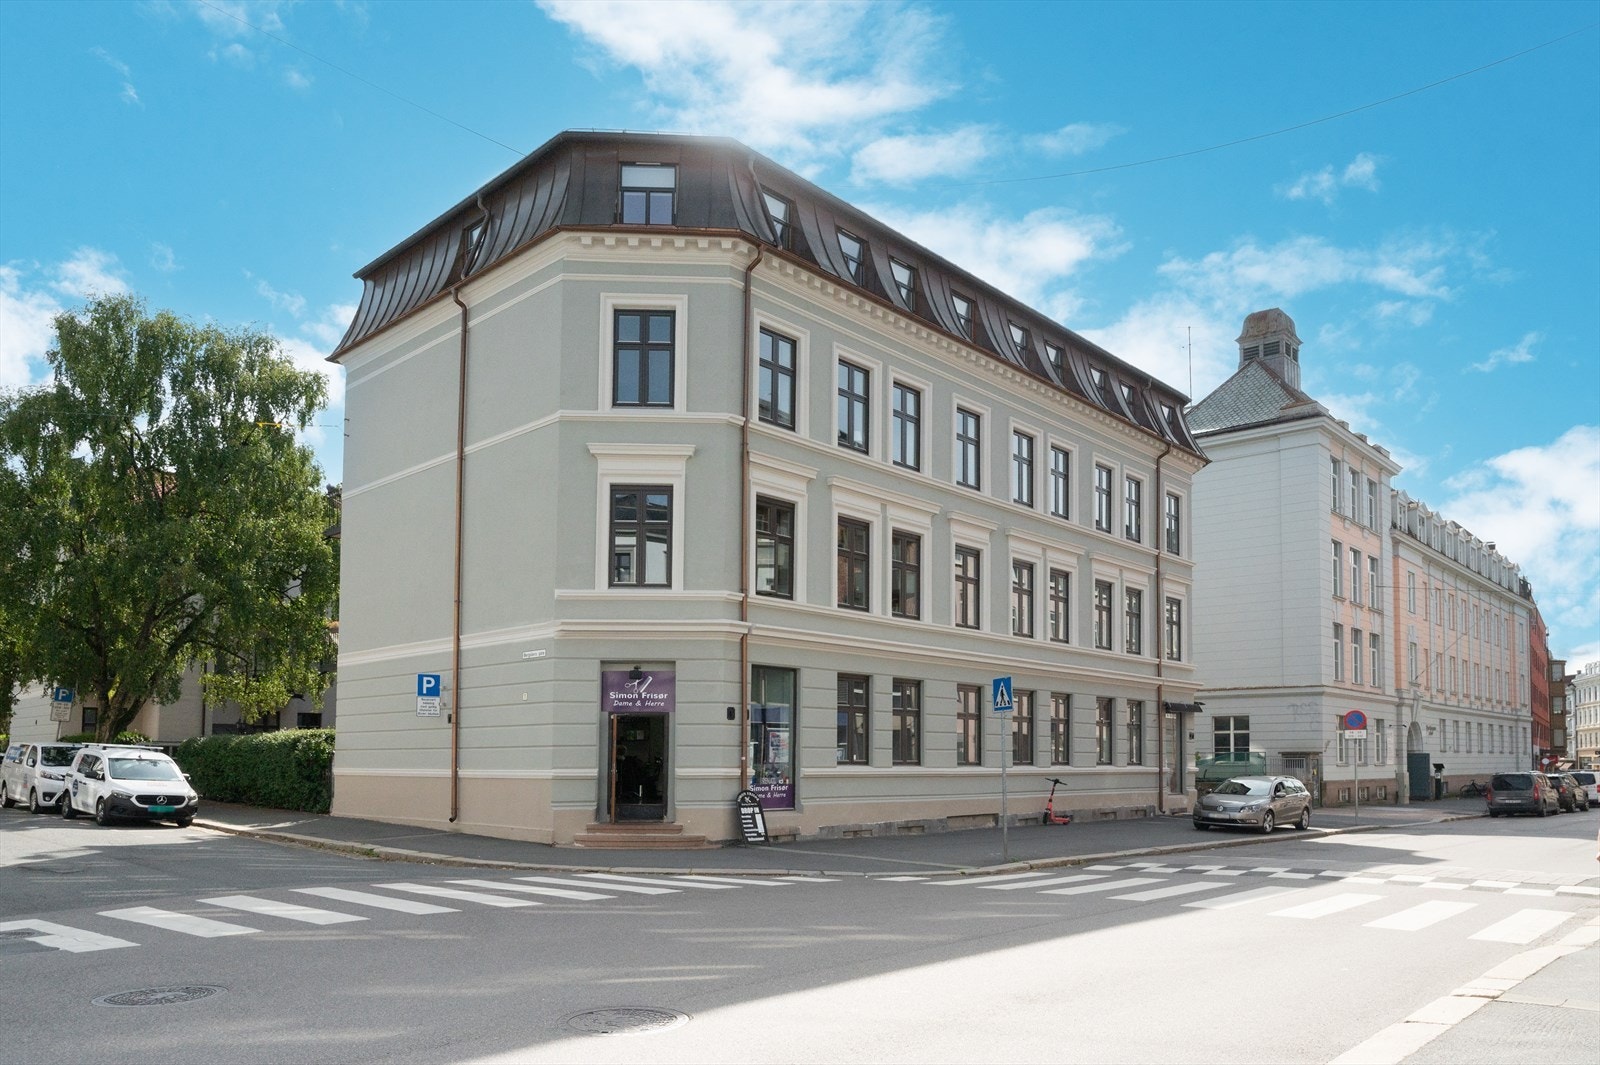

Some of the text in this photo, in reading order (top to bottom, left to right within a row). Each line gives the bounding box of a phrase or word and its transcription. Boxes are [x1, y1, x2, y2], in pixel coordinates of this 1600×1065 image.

[423, 677, 435, 694] P
[58, 688, 69, 700] P
[609, 691, 668, 699] Simon Frisør
